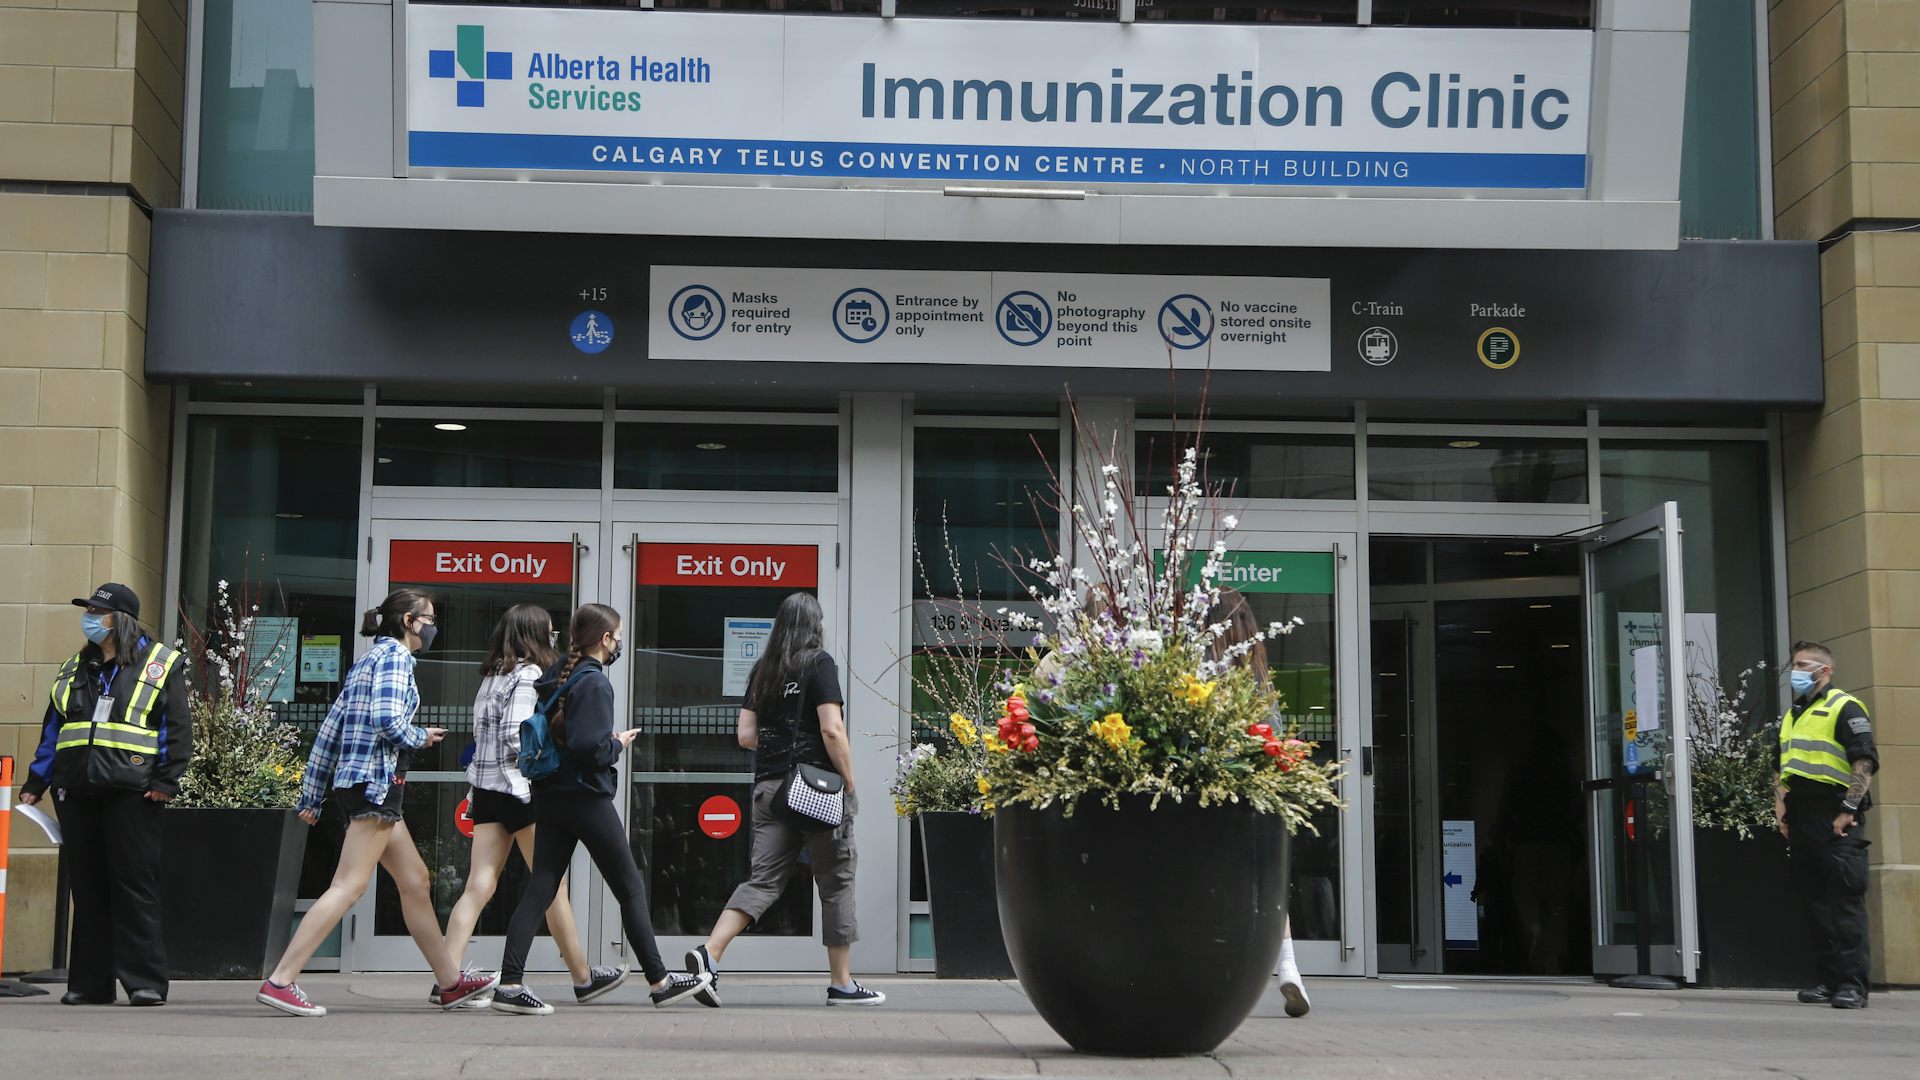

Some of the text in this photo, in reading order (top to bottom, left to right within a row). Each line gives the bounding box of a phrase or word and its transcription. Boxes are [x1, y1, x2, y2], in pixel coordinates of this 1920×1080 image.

[528, 53, 710, 83] Alberta Health
[529, 83, 640, 111] Services
[862, 63, 1569, 130] Immunization Clinic
[592, 145, 1409, 178] CALGARY TELUS CONVENTION CENTRE NORTH BUILDING
[580, 288, 606, 300] +15
[733, 292, 777, 303] Masks
[1058, 291, 1076, 301] No
[896, 295, 978, 309] Entrance by
[1221, 301, 1297, 313] No vaccine
[1352, 302, 1403, 315] C-Train
[732, 307, 789, 320] required
[896, 310, 983, 322] appointment
[1058, 306, 1145, 320] photography
[1471, 303, 1525, 317] Parkade
[731, 322, 791, 335] for entry
[1058, 320, 1138, 334] beyond this
[1221, 317, 1311, 328] stored onsite
[896, 324, 924, 337] only
[1221, 331, 1286, 344] overnight
[1058, 334, 1093, 348] point
[436, 553, 546, 577] Exit Only
[677, 556, 785, 580] Exit Only
[1218, 562, 1282, 582] Enter
[97, 590, 113, 600] STAFF
[931, 615, 956, 631] 136
